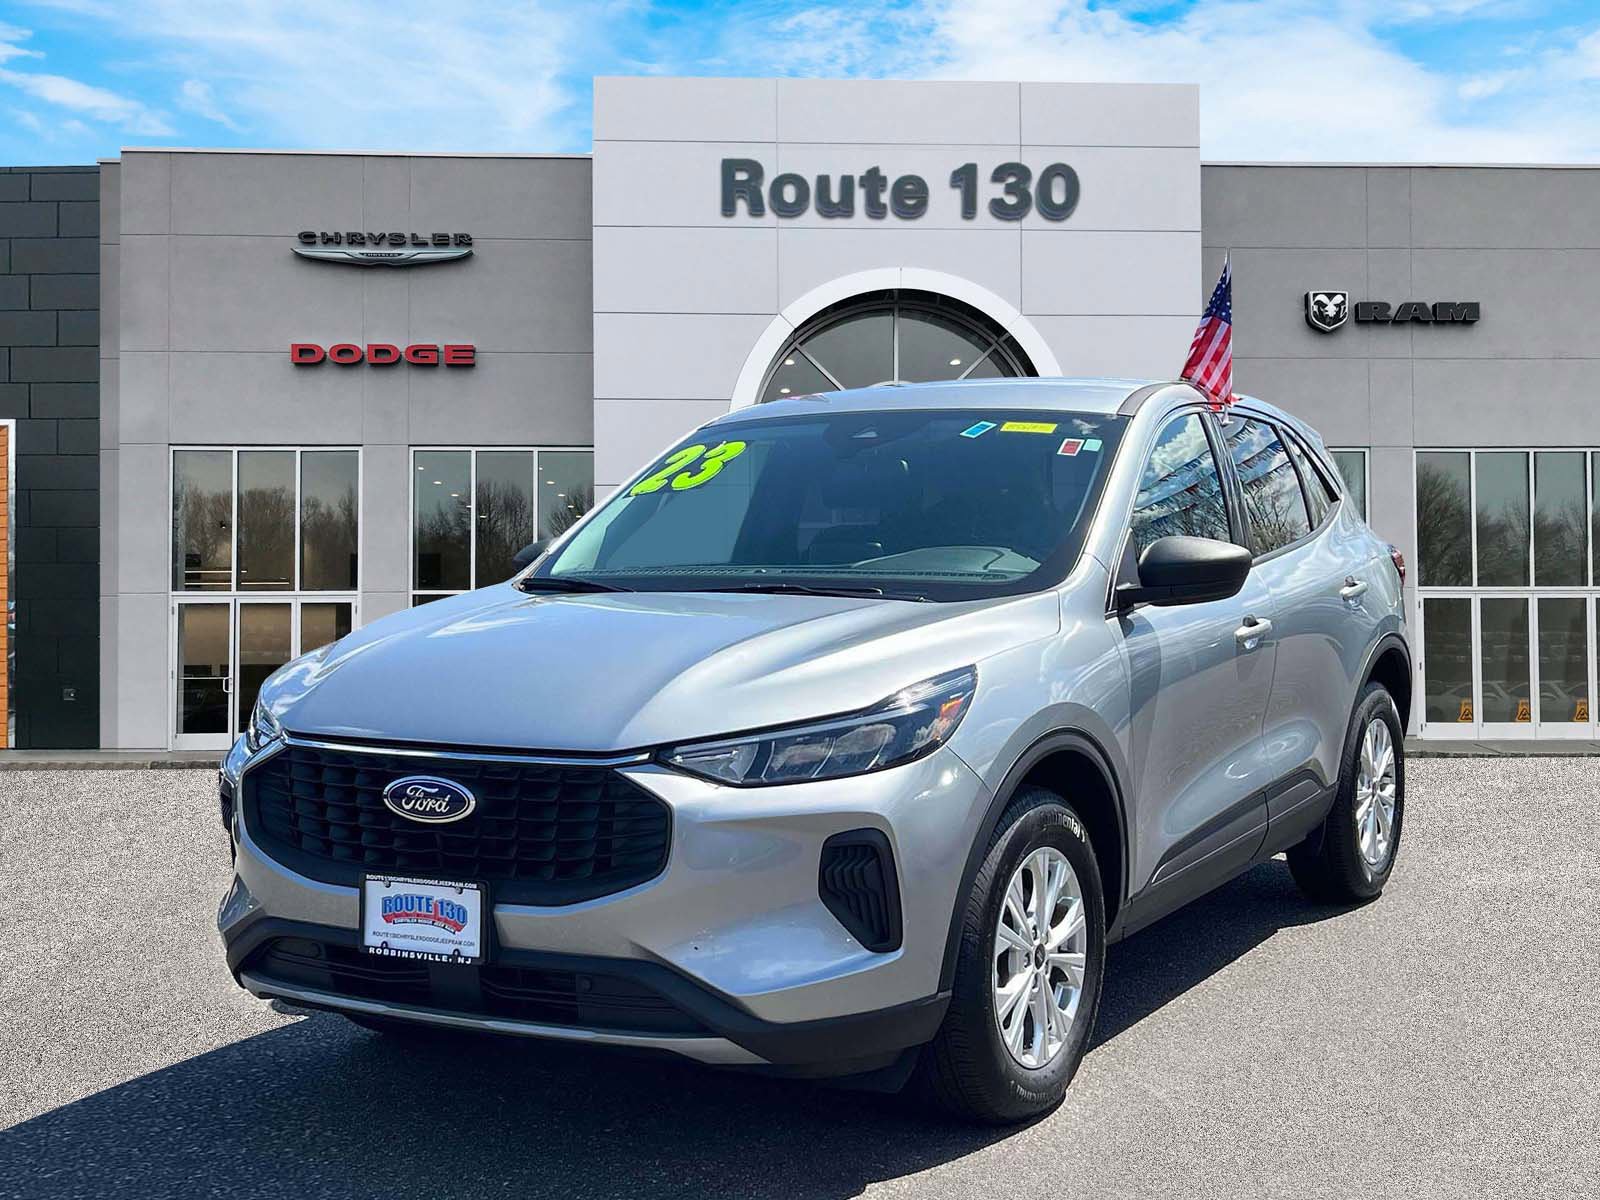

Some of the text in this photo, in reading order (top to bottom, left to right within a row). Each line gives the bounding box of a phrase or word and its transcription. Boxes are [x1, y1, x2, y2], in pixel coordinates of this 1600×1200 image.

[721, 158, 1081, 222] Route 130
[297, 231, 473, 246] CHRYSLER
[1354, 302, 1481, 323] RAM
[290, 343, 476, 366] DODGE
[630, 441, 747, 497] 23
[401, 785, 451, 813] Ford
[382, 893, 467, 925] ROUTE 130
[457, 956, 472, 965] NJ
